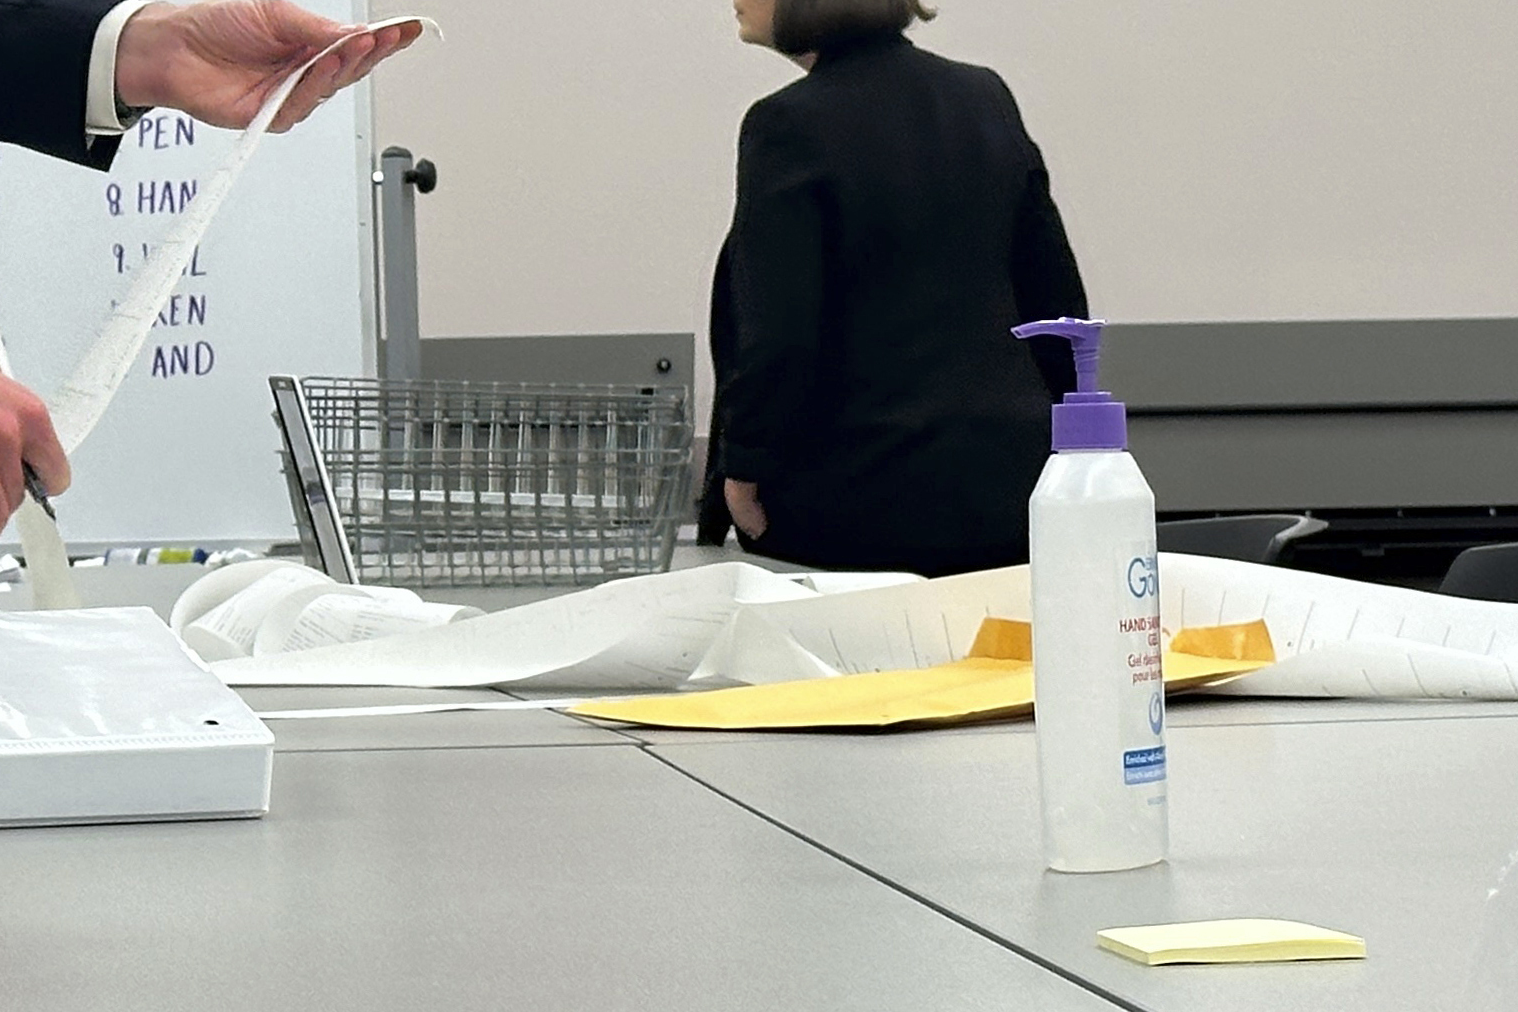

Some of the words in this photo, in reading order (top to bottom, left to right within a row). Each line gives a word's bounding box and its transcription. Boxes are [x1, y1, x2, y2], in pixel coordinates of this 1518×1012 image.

[138, 116, 194, 150] PEN
[151, 340, 215, 379] AND
[1119, 617, 1146, 633] HAND
